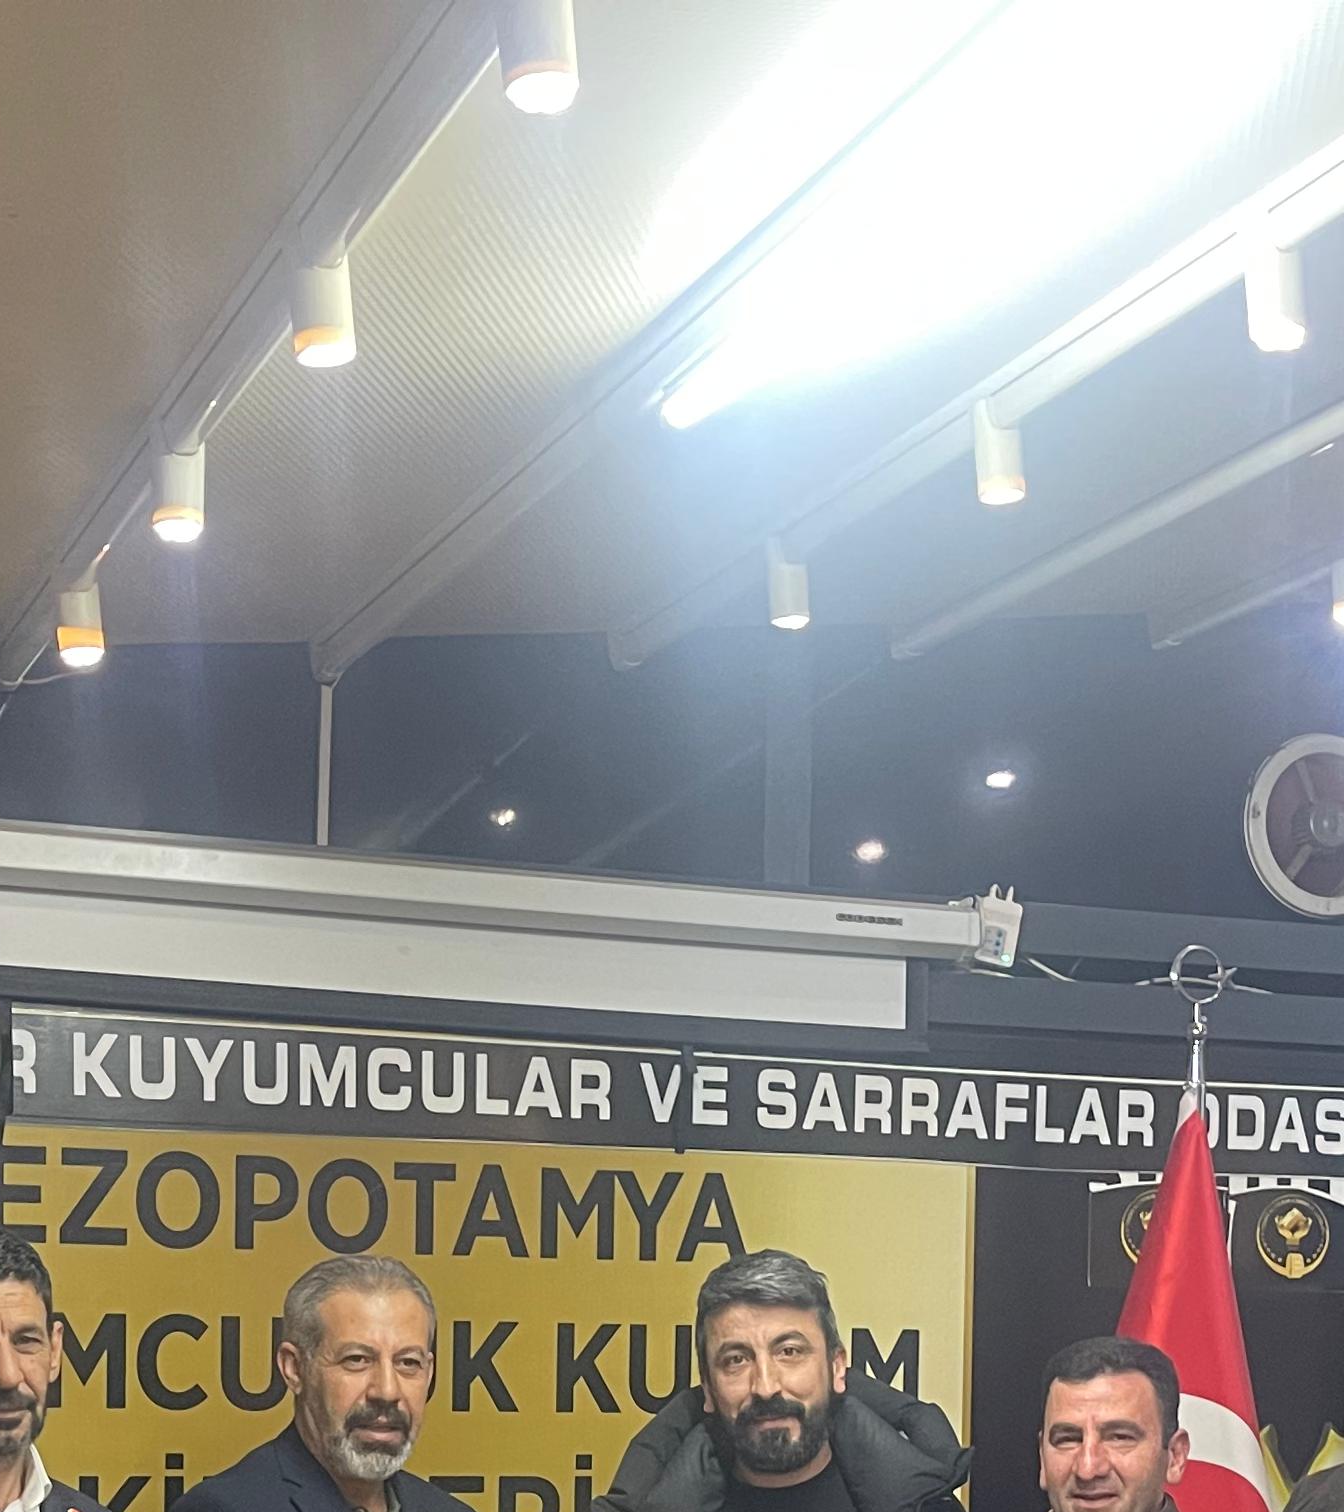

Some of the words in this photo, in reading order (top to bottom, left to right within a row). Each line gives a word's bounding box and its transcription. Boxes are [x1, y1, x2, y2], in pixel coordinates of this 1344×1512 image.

[72, 1031, 613, 1121] KUYUMCULAR
[638, 1061, 730, 1127] VE
[756, 1068, 1155, 1149] SARRAFLAR
[555, 1321, 921, 1414] KUM
